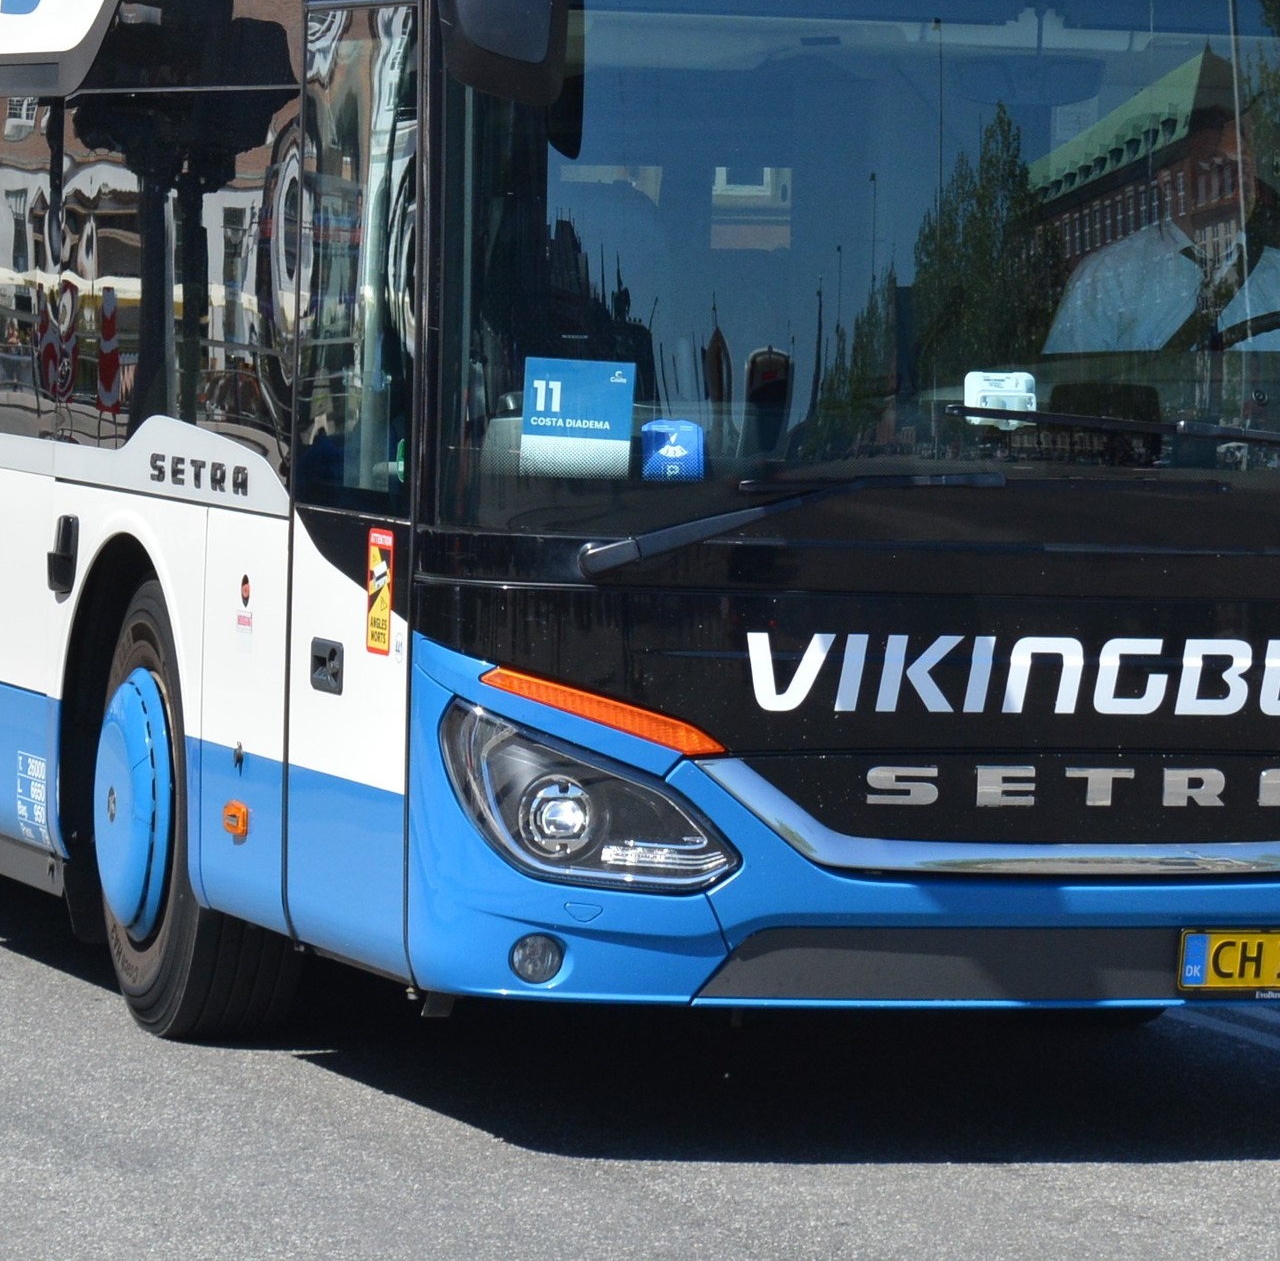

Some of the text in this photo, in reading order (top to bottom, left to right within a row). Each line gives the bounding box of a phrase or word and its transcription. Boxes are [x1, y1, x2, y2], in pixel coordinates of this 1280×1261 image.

[533, 380, 561, 412] 11
[531, 416, 610, 430] COSTA DIADEMA
[149, 452, 249, 497] SETRA
[1185, 965, 1202, 978] DK
[1211, 940, 1265, 979] CH
